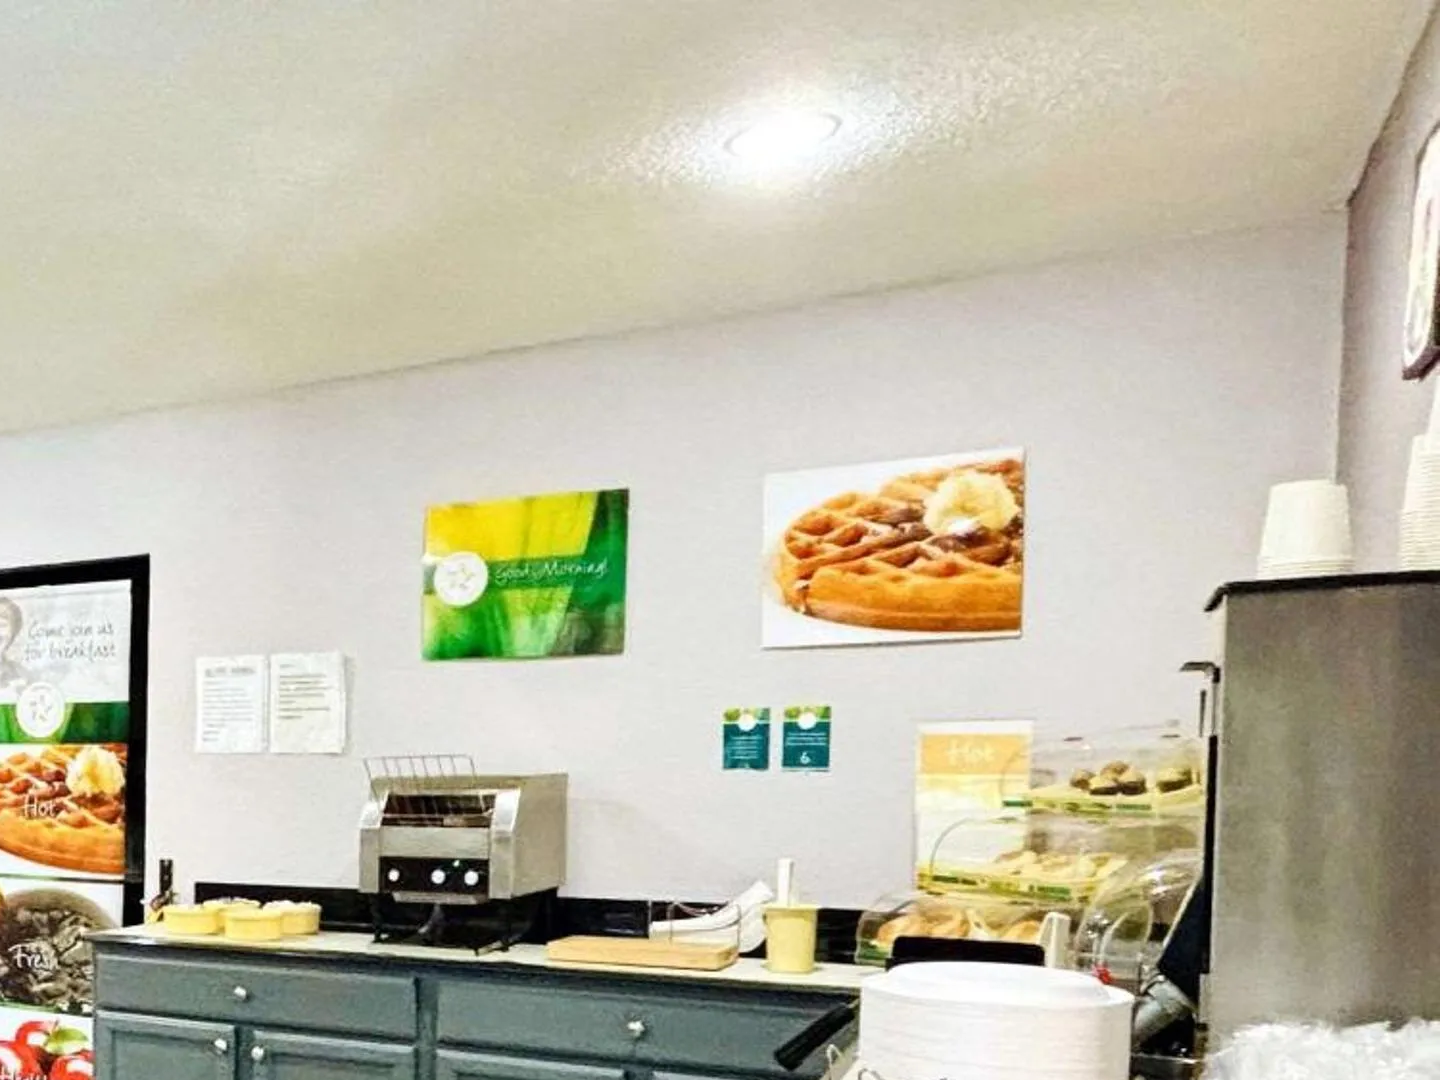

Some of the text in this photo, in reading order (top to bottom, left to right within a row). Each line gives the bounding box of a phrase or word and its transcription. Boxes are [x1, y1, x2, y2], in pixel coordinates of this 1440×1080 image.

[49, 641, 116, 663] breakfast
[24, 792, 57, 818] Hot
[8, 943, 60, 970] Fresh
